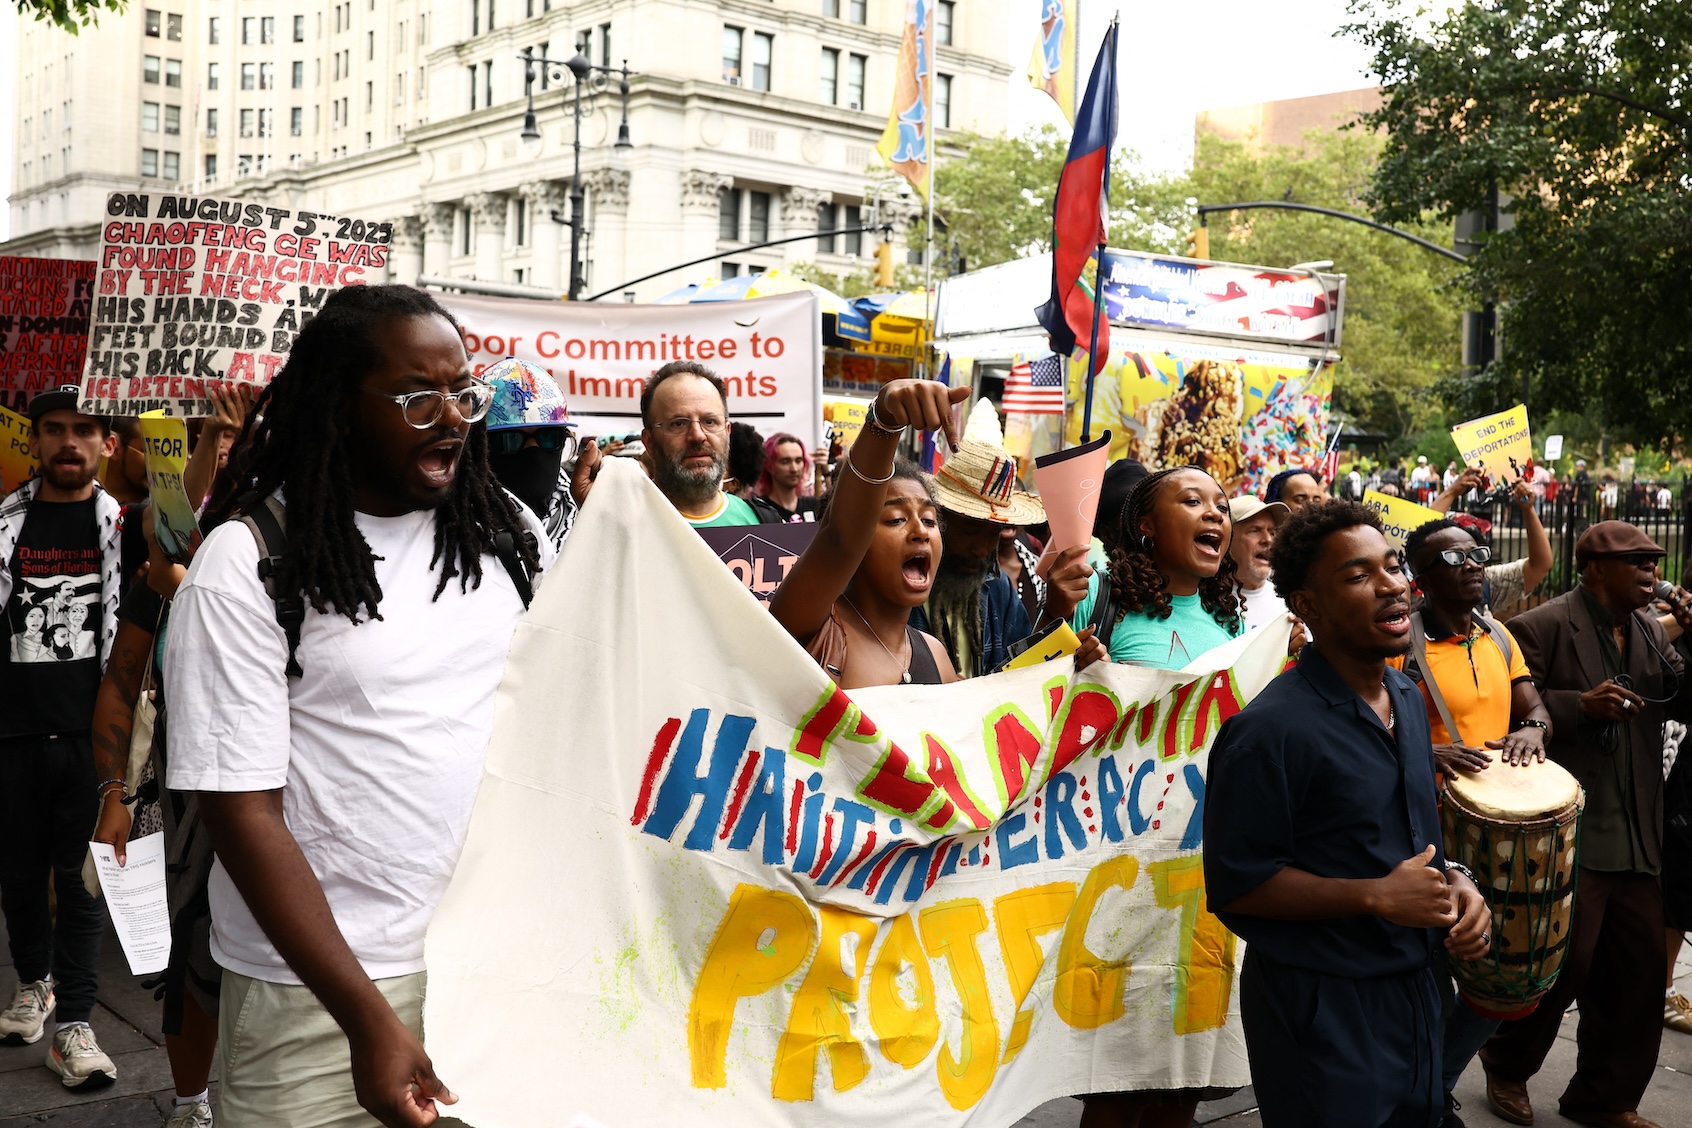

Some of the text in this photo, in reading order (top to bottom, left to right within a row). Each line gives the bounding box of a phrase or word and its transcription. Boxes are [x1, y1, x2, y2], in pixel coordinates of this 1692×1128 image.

[107, 193, 149, 217] ON
[157, 196, 290, 230] AUGUST
[104, 221, 388, 267] CHAOFENG GE WAS
[0, 257, 67, 277] AITIAN
[102, 245, 366, 286] FOUND HANGING
[99, 269, 133, 295] BY
[140, 270, 194, 295] THE
[96, 296, 146, 324] HIS
[152, 296, 262, 325] HANDS
[92, 325, 156, 349] FEET
[161, 322, 267, 350] BOUND
[461, 326, 785, 361] bor Committee to
[88, 351, 140, 378] HIS
[226, 351, 282, 383] AT
[85, 377, 121, 399] ICE
[1475, 416, 1516, 439] END THE
[153, 437, 182, 458] FOR
[19, 546, 101, 561] Daughters and
[21, 560, 50, 575] Sons
[51, 561, 62, 573] of
[686, 853, 1239, 1112] PROJECT
